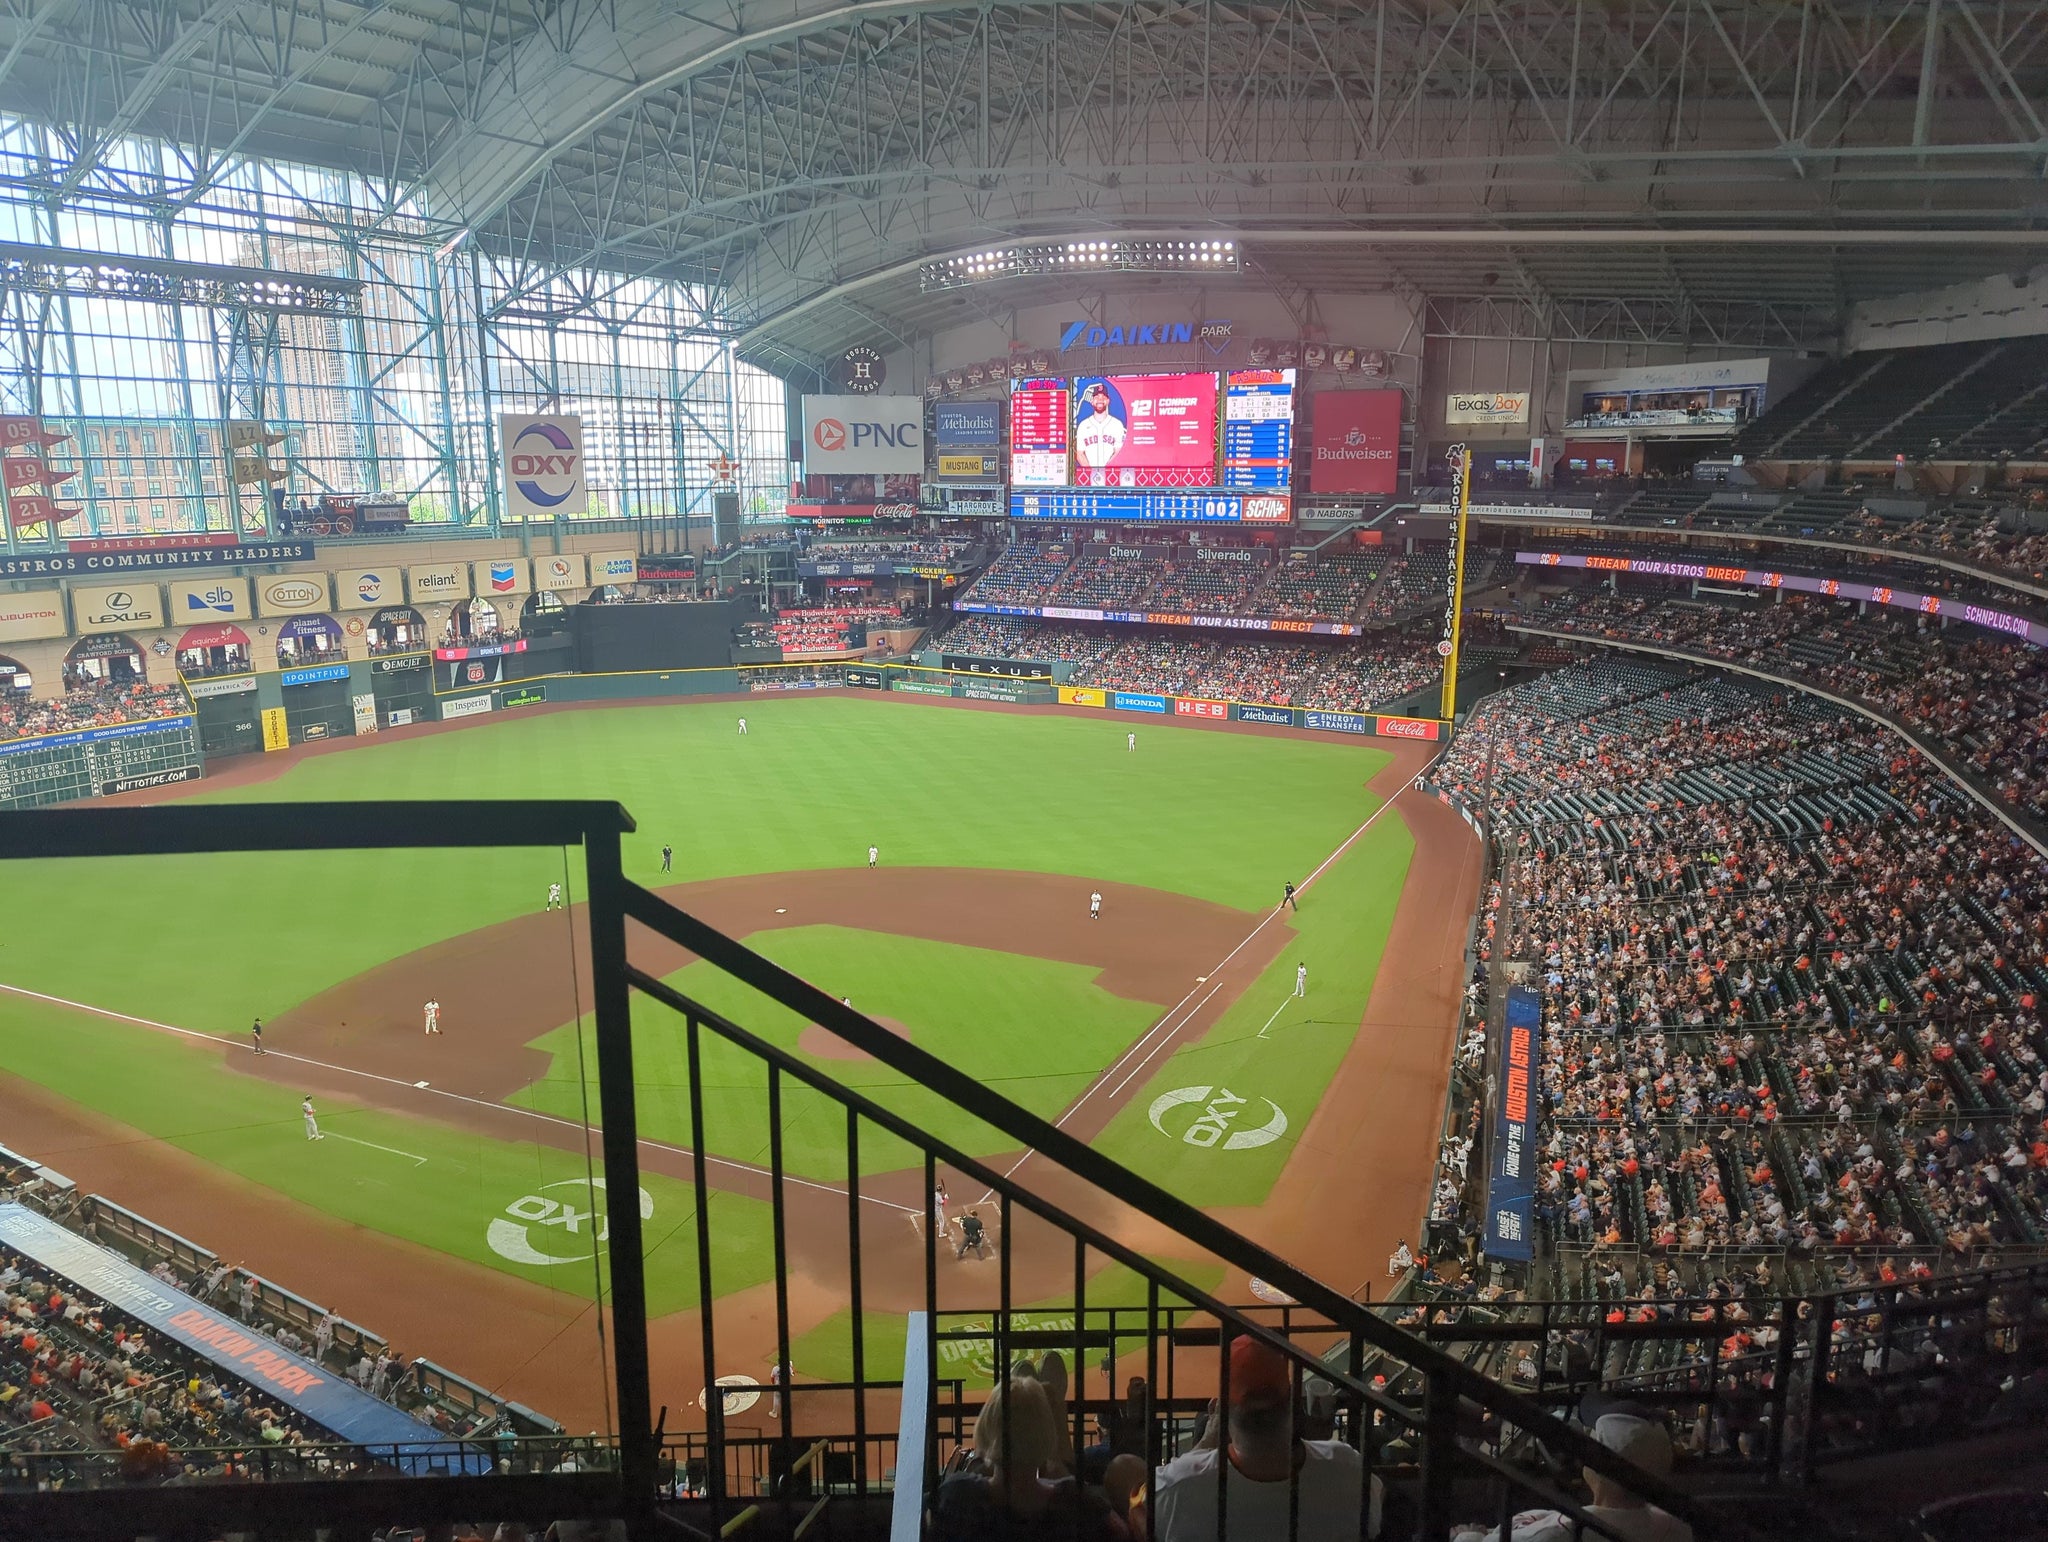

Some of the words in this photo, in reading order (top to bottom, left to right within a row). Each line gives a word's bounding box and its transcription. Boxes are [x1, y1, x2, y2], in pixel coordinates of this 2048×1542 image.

[1086, 322, 1193, 347] DAIKIN
[1201, 324, 1232, 337] PARK
[845, 347, 880, 361] HOUSTON
[855, 362, 871, 379] H
[1236, 371, 1274, 383] ASTROS
[847, 379, 880, 391] ASTROS
[1131, 399, 1152, 416] 12
[1158, 398, 1198, 406] CONNOR
[1452, 396, 1490, 411] Texas
[1495, 395, 1523, 414] Bay
[1159, 407, 1186, 416] WONG
[941, 415, 994, 430] Methodist
[6, 422, 31, 439] 05
[239, 426, 256, 440] 17
[849, 422, 918, 448] PNC
[1083, 434, 1098, 447] RED
[1102, 434, 1116, 446] SOX
[1316, 447, 1392, 460] Budweiser
[14, 464, 37, 479] 19
[242, 464, 260, 477] 22
[511, 454, 577, 476] OXY
[945, 461, 979, 471] MUSTANG
[983, 460, 995, 471] CAT
[1024, 497, 1039, 505] BOS
[1450, 473, 1462, 517] ROOT
[20, 502, 41, 517] 21
[873, 503, 917, 518] Coca-Cola
[957, 501, 998, 513] HARGROVE
[1206, 502, 1215, 516] 0
[1217, 502, 1225, 516] 0
[1229, 502, 1238, 516] 2
[1246, 500, 1286, 518] SCHN+
[1467, 506, 1501, 514] SUPERIOR
[1316, 510, 1354, 518] NABORS
[1449, 521, 1458, 533] 4
[91, 539, 156, 549] DAIKIN
[170, 536, 212, 545] PARK
[87, 549, 214, 568] COMMUNITY
[223, 546, 302, 560] LEADERS
[1109, 546, 1142, 559] Chevy
[1197, 548, 1251, 562] Silverado
[1447, 537, 1458, 571] THA
[1539, 553, 1561, 566] SCHN+
[607, 559, 633, 575] LNG
[911, 567, 947, 575] PLUCKERS
[1585, 556, 1630, 570] STREAM
[1631, 560, 1660, 572] YOUR
[1662, 561, 1704, 577] ASTROS
[1706, 566, 1746, 581] DIRECT
[418, 574, 456, 587] reliant
[638, 569, 694, 579] Budweiser
[206, 586, 233, 603] slb
[273, 586, 314, 601] COTTON
[358, 583, 381, 593] OXY
[1443, 574, 1456, 639] CHIKIN
[0, 610, 56, 622] LIBURTON
[88, 611, 152, 624] LEXUS
[380, 611, 398, 622] SPACE
[398, 609, 412, 620] CITY
[1074, 610, 1099, 618] FIBER
[292, 617, 321, 628] planet
[1147, 614, 1191, 625] STREAM
[1193, 616, 1221, 628] YOUR
[1224, 618, 1268, 629] ASTROS
[1270, 620, 1314, 633] DIRECT
[1965, 605, 2029, 637] SCHNPLUS.COM
[297, 626, 327, 635] fitness
[1331, 623, 1356, 636] SCHN+
[86, 642, 121, 650] LANDRY'S
[192, 635, 220, 646] equinor
[801, 644, 838, 652] Budweiser
[76, 651, 112, 659] CRAWFORD
[390, 657, 421, 669] EMCJET
[951, 662, 1042, 677] LEXUS
[286, 668, 346, 683] 1POINTFIVE
[211, 683, 240, 691] AMERICA
[454, 698, 488, 711] Insperity
[1125, 698, 1163, 708] HONDA
[356, 707, 374, 715] WM
[1241, 709, 1289, 723] Methodist
[1321, 713, 1354, 723] ENERGY
[235, 722, 252, 733] 366
[1320, 721, 1363, 732] TRANSFER
[1386, 720, 1427, 736] Coca-Cola
[54, 735, 77, 743] UNITED
[3, 744, 20, 752] LEADS
[88, 746, 100, 795] AMERICAN
[116, 770, 187, 792] NITTOTIRE.COM
[1509, 1026, 1530, 1069] ASTROS
[1505, 1066, 1528, 1123] HOUSTON
[1183, 1087, 1247, 1148] OXY
[1509, 1123, 1522, 1141] THE
[1507, 1140, 1520, 1154] OF
[1505, 1153, 1520, 1178] HOME
[90, 1264, 155, 1302] WELCOME
[148, 1297, 174, 1312] TO
[168, 1309, 259, 1364] DAIKIN
[253, 1349, 325, 1396] PARK
